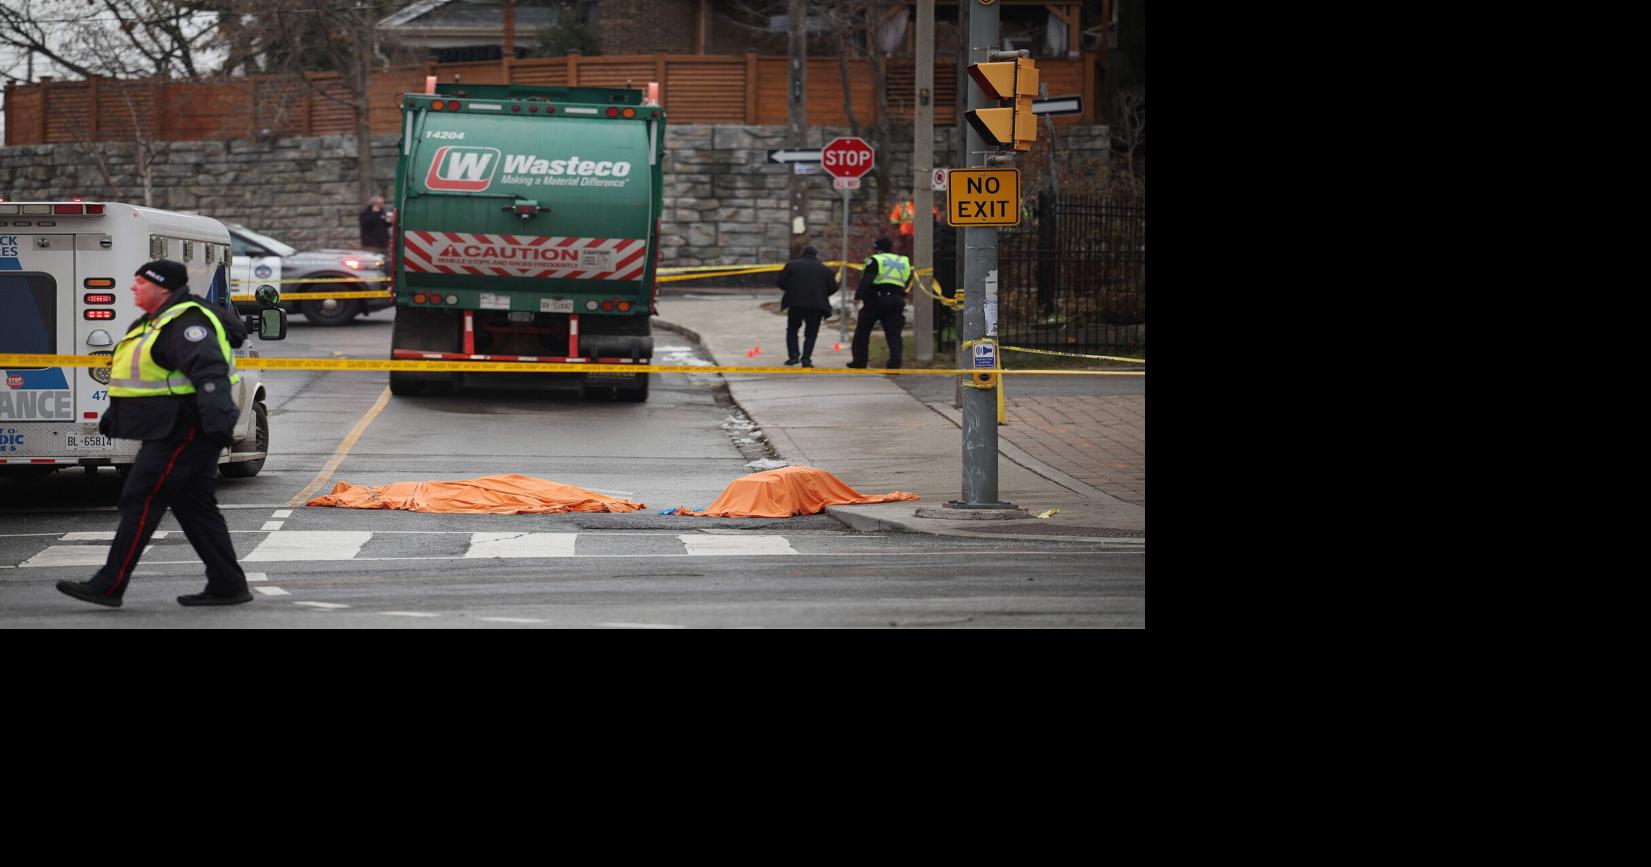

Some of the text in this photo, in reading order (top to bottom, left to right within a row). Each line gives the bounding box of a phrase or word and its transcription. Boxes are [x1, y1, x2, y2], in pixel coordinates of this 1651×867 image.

[426, 131, 465, 140] 14204
[503, 154, 631, 177] Wasteco
[825, 150, 871, 166] STOP
[447, 152, 493, 182] W
[501, 175, 533, 186] Making
[543, 176, 579, 186] Material
[580, 178, 624, 188] Difference
[967, 176, 1000, 194] NO
[958, 200, 1010, 218] EXIT
[0, 247, 18, 256] ES
[463, 245, 579, 262] CAUTION
[437, 257, 465, 265] VEHICLE
[0, 391, 71, 419] ANCE
